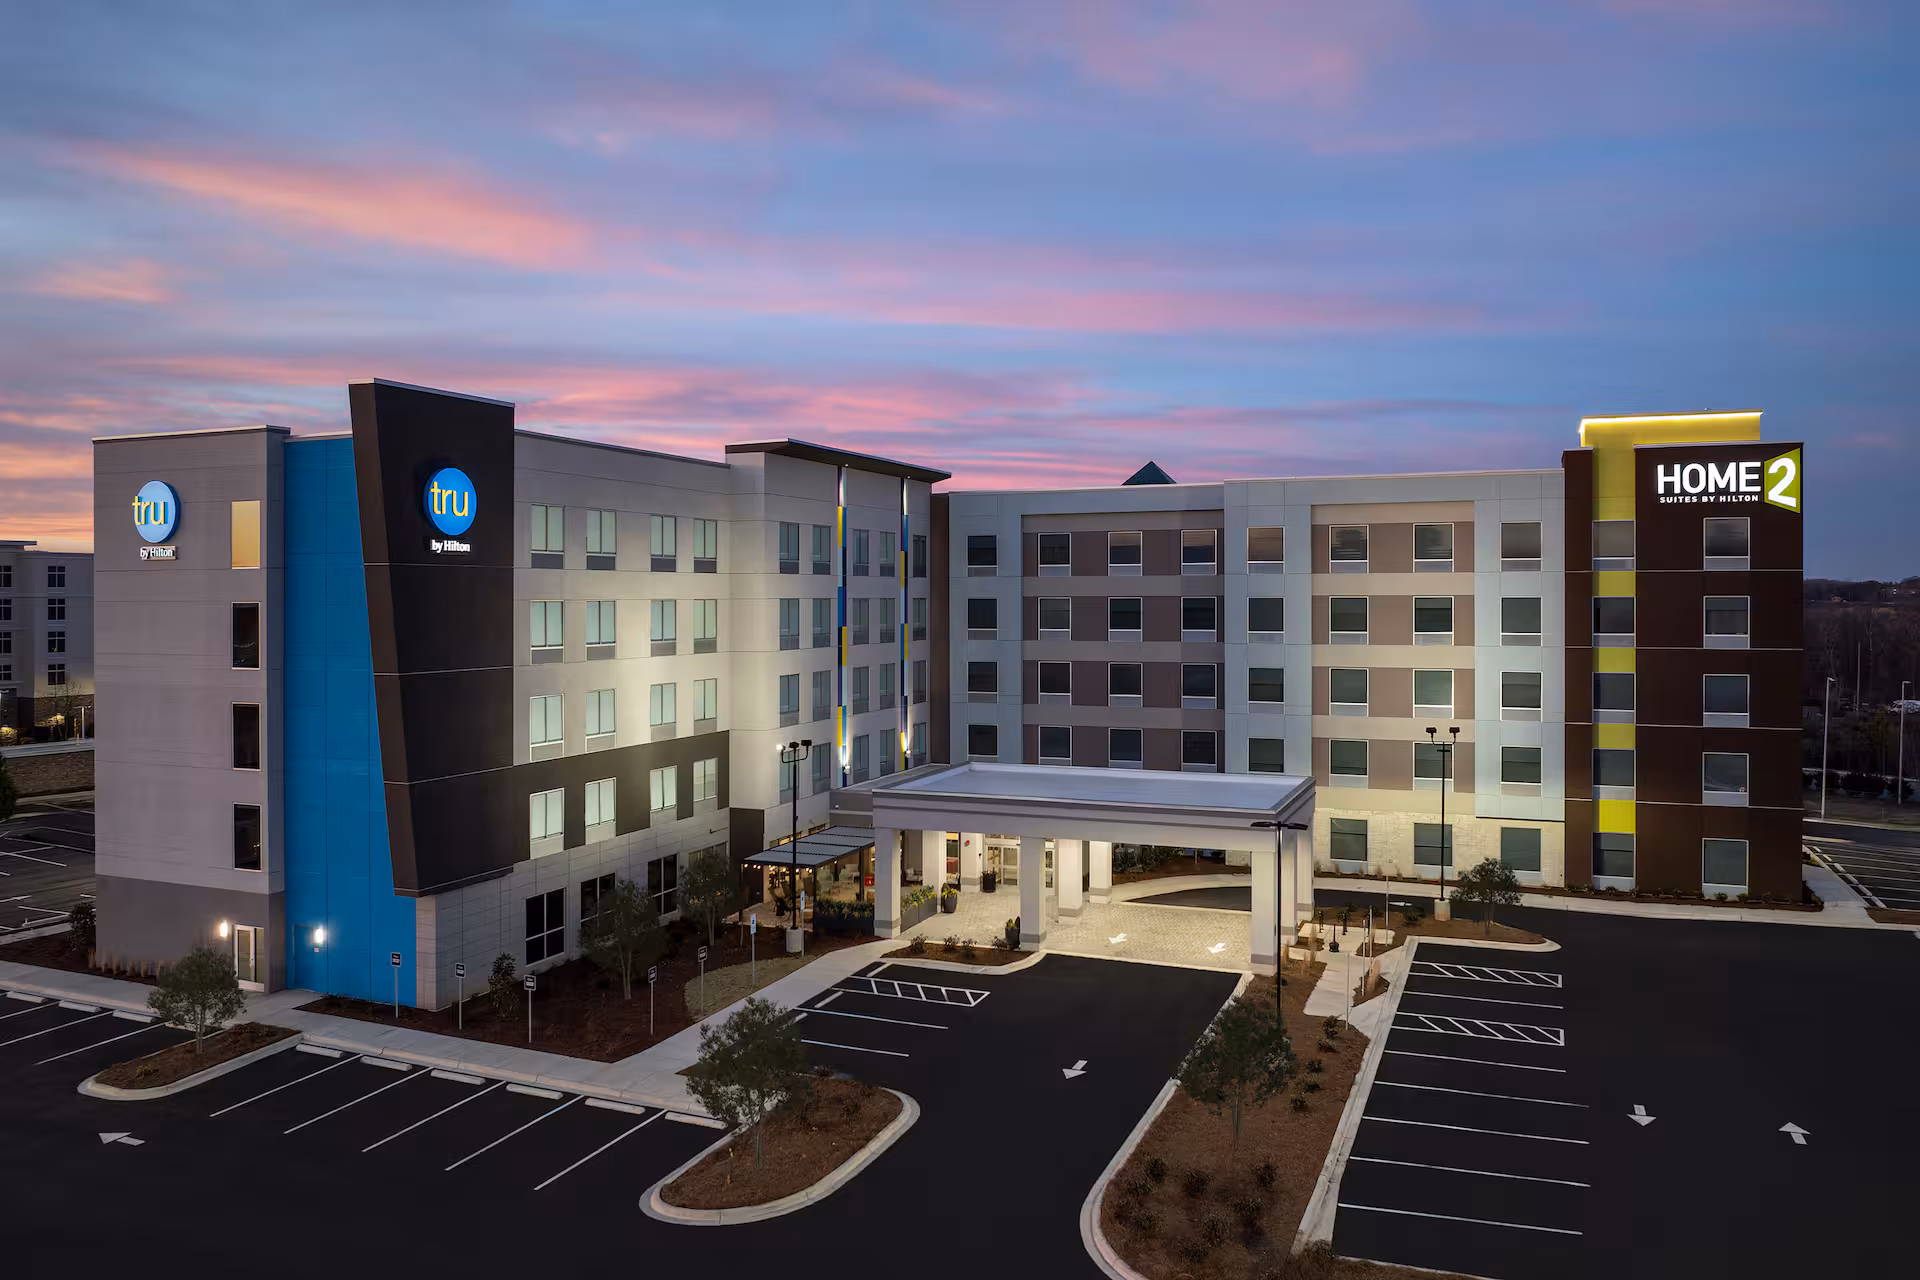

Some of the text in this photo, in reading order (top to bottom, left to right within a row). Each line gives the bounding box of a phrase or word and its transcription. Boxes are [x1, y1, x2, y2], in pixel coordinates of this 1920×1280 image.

[1657, 457, 1797, 508] HOME 2
[131, 495, 167, 525] tru
[430, 481, 469, 517] tru
[1659, 494, 1759, 504] SUITES BY HILTON
[140, 547, 174, 560] by Hilton
[431, 539, 471, 554] by Hilton
